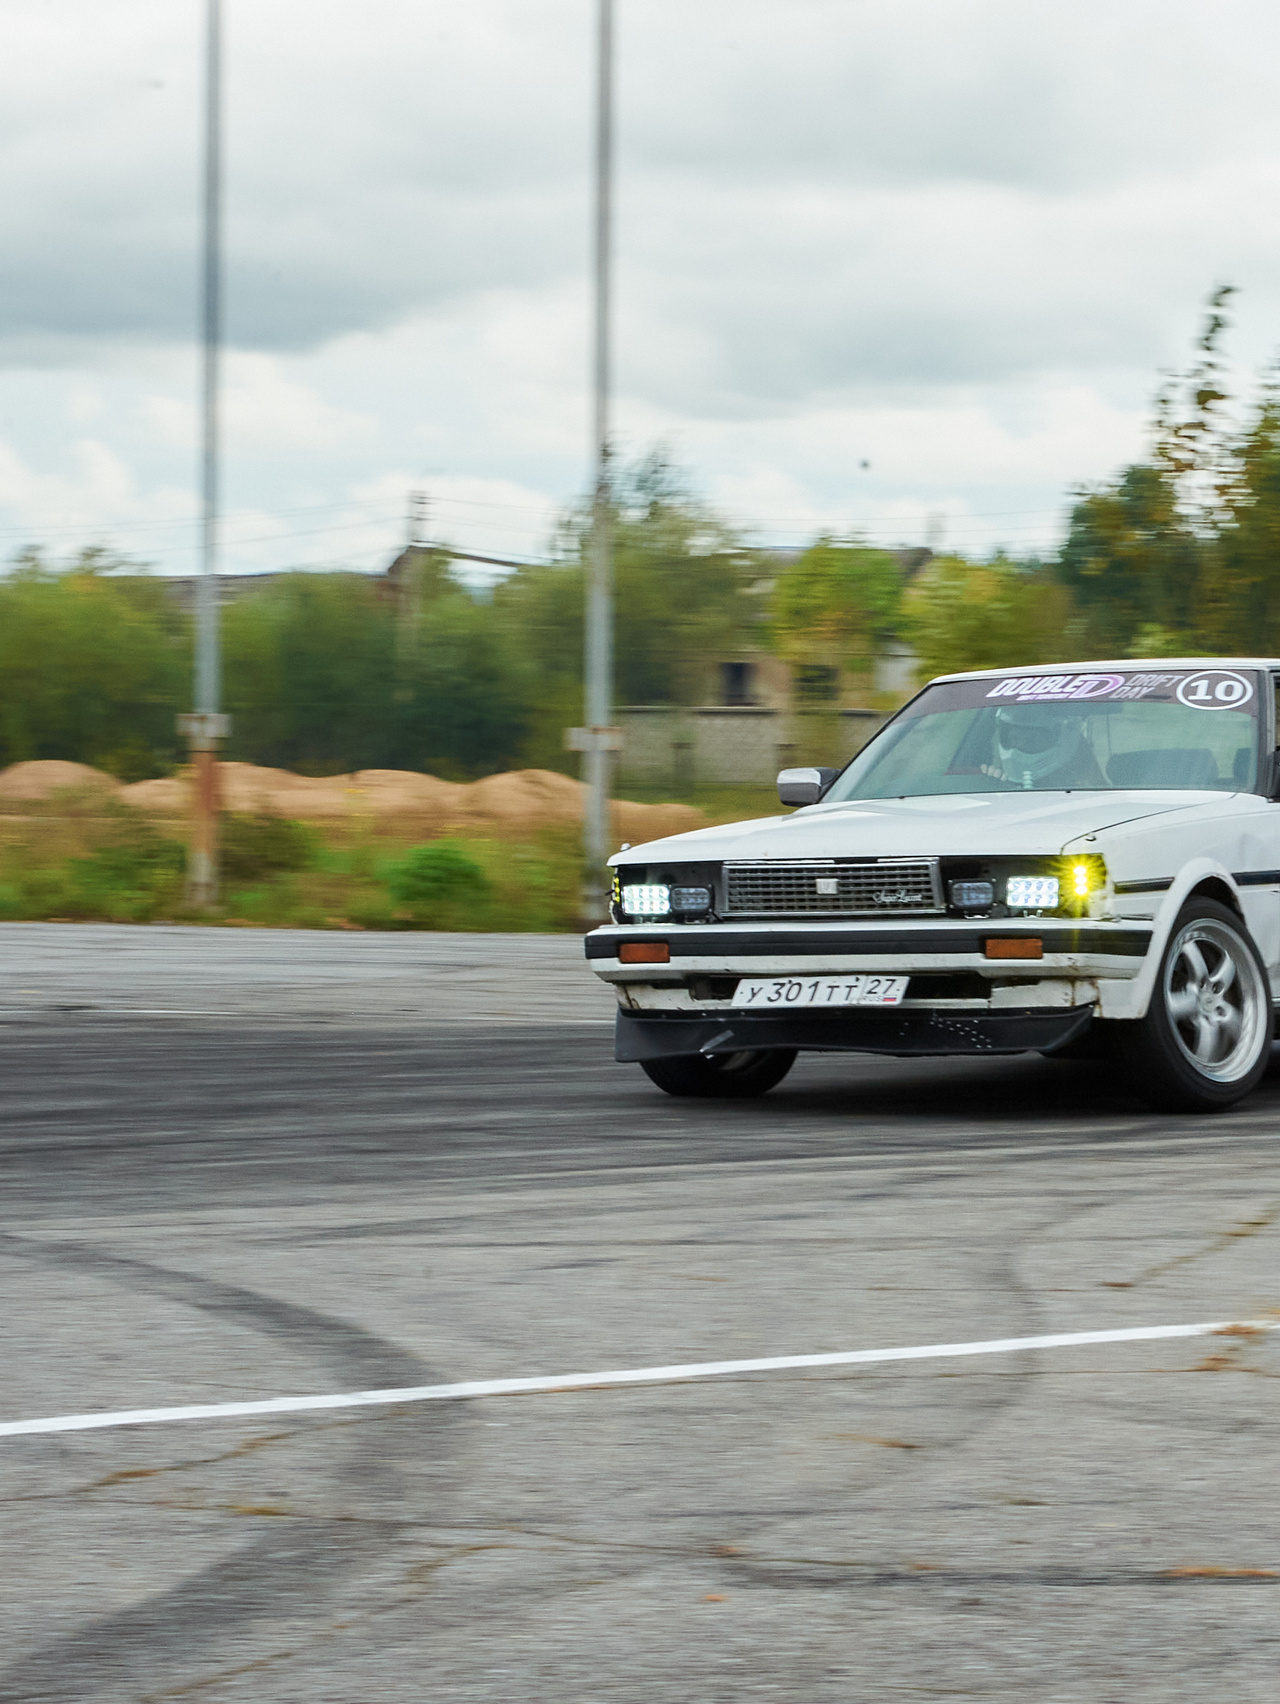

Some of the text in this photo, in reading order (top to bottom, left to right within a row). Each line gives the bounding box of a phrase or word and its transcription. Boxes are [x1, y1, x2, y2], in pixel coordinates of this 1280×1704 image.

[1125, 674, 1185, 687] DRIFT
[1109, 686, 1154, 699] DAY
[1188, 679, 1244, 701] 10
[866, 978, 897, 995] 27
